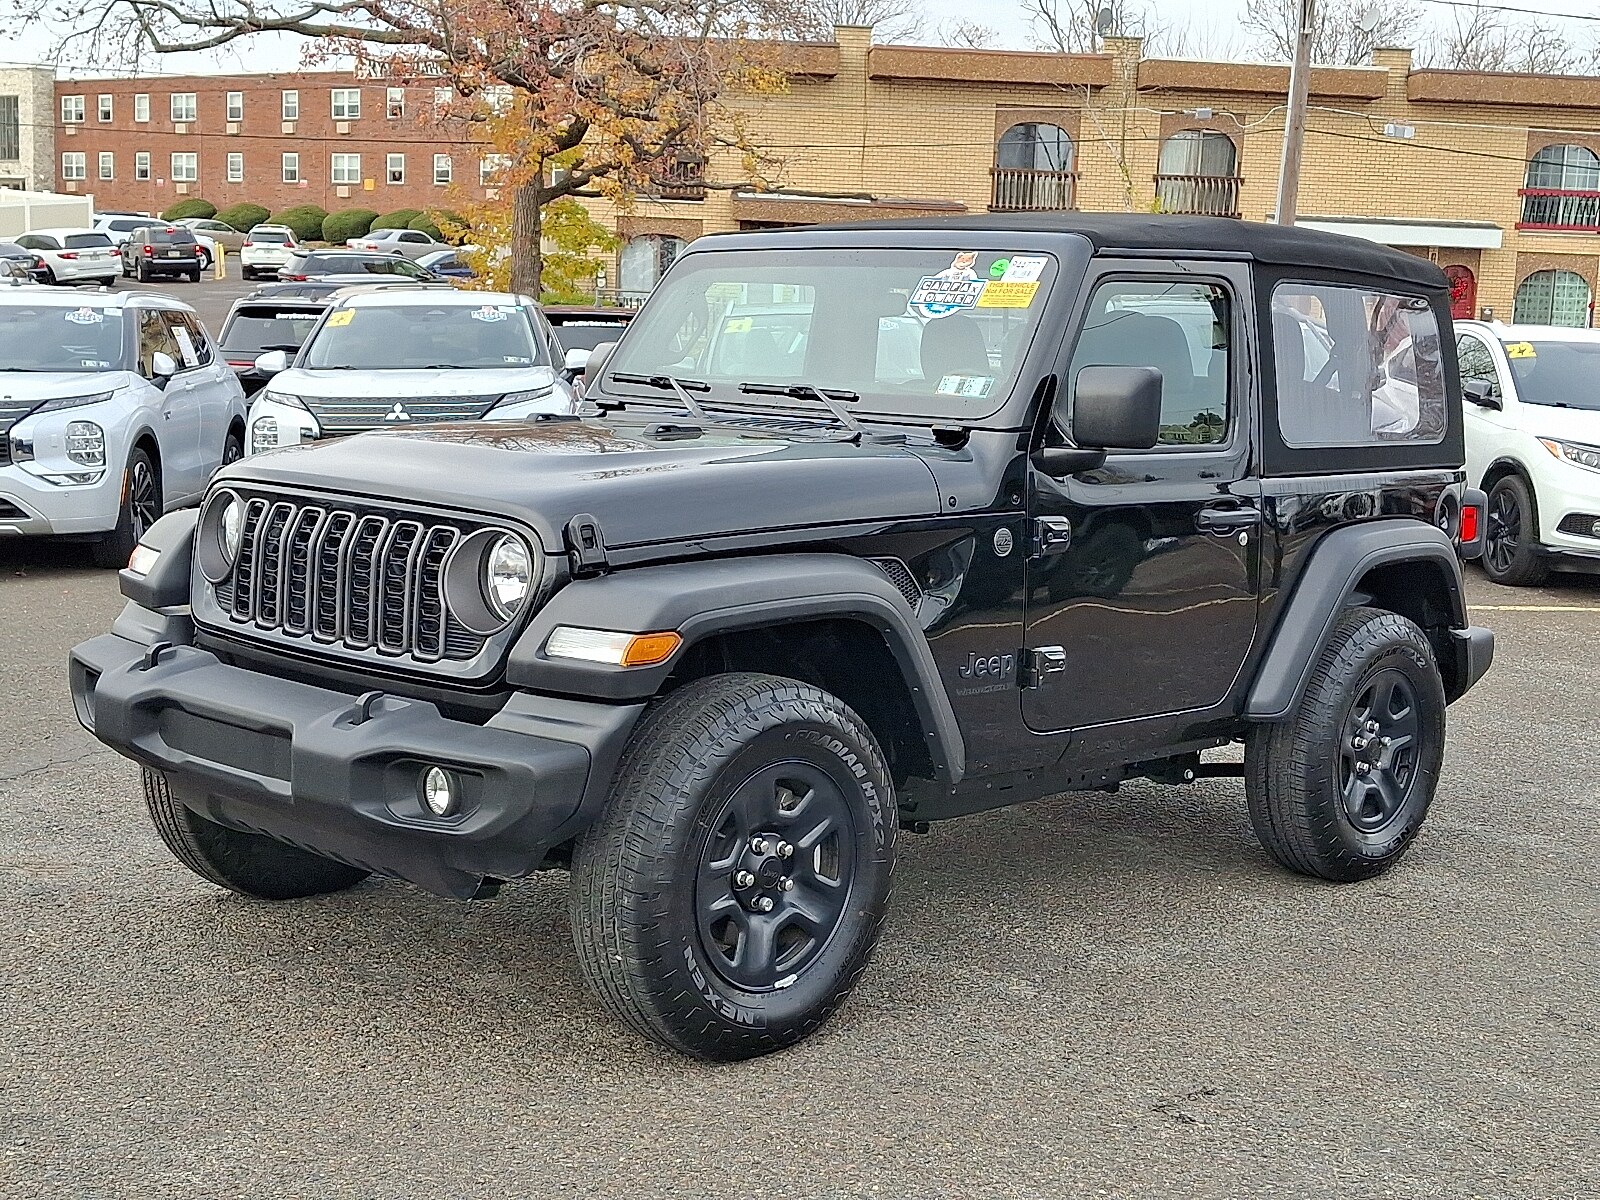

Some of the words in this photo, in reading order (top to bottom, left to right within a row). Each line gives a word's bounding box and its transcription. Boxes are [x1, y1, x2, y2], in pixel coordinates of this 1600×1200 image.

[921, 280, 979, 294] CARFAX
[924, 292, 976, 305] OWNER
[958, 651, 1014, 680] Jeep
[683, 945, 754, 1025] NEXEN
